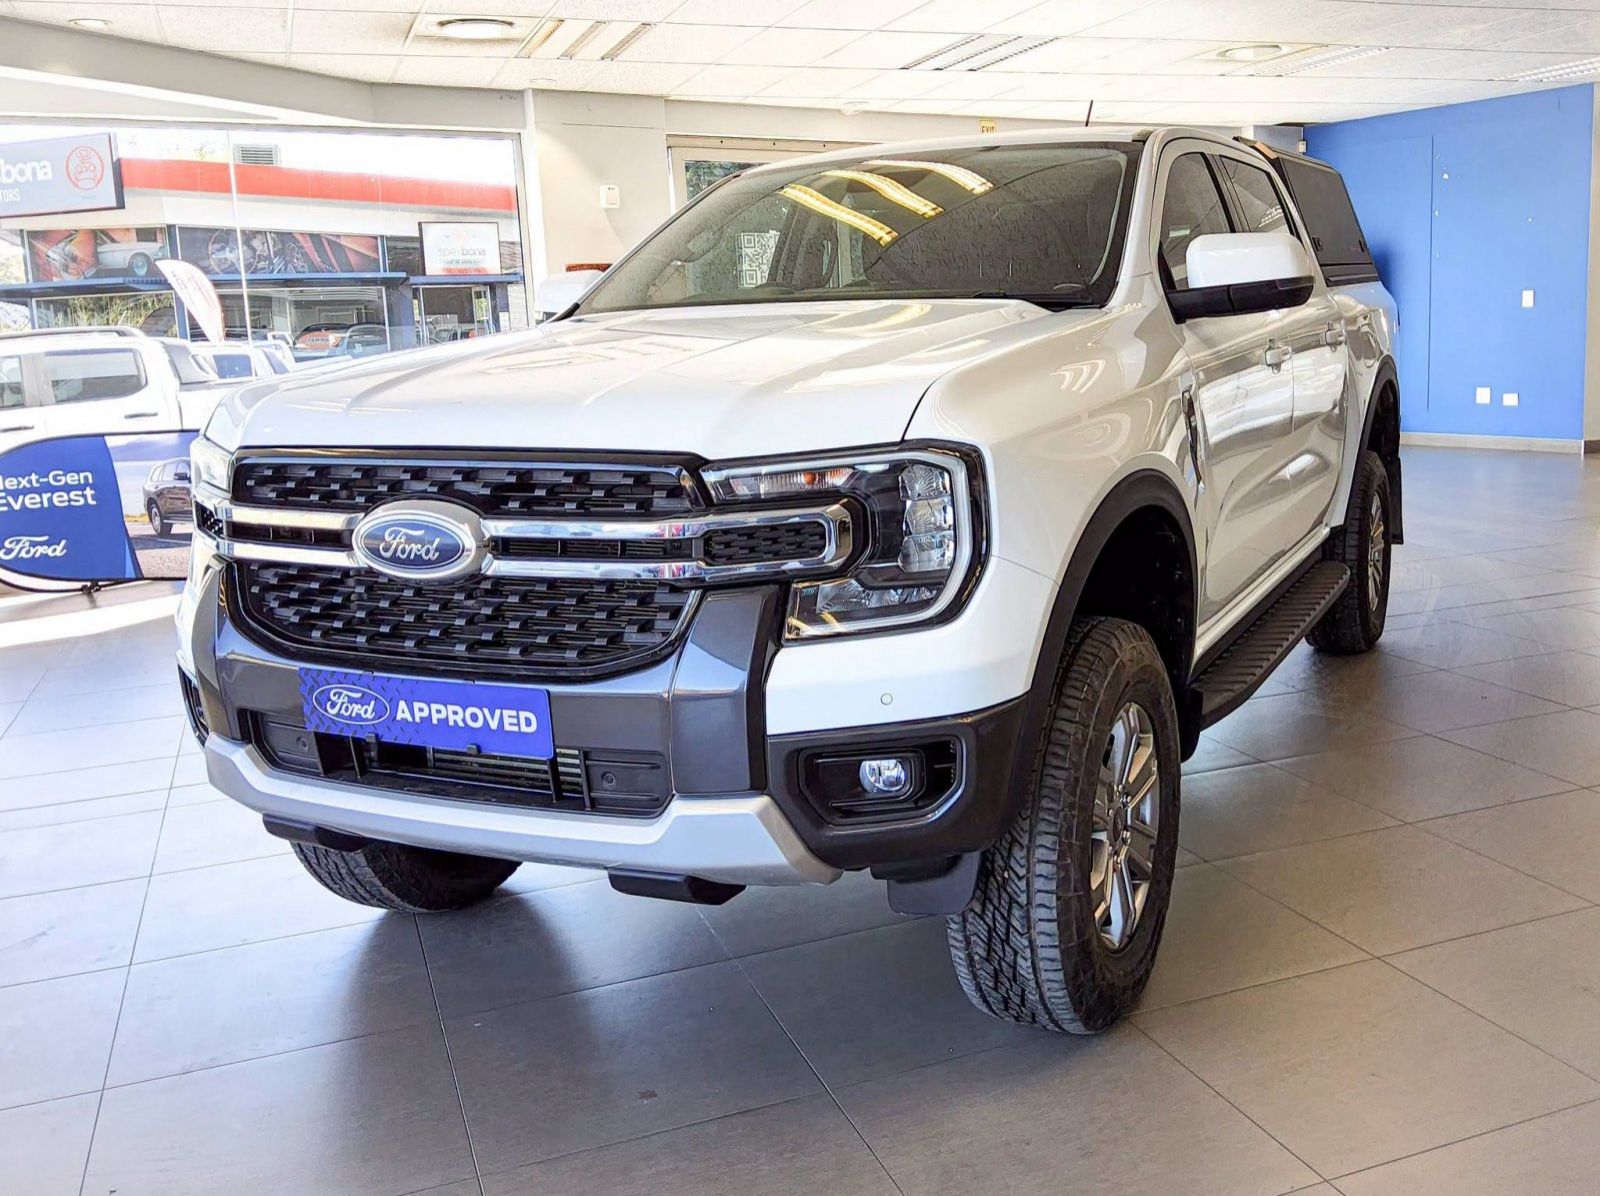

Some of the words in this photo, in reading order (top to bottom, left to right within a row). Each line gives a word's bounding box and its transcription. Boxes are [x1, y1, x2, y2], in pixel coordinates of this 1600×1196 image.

[0, 158, 53, 184] bona
[0, 470, 93, 490] ext-Gen
[0, 535, 68, 560] Ford
[379, 526, 441, 561] Ford
[326, 688, 376, 720] Ford
[395, 699, 538, 733] APPROVED
